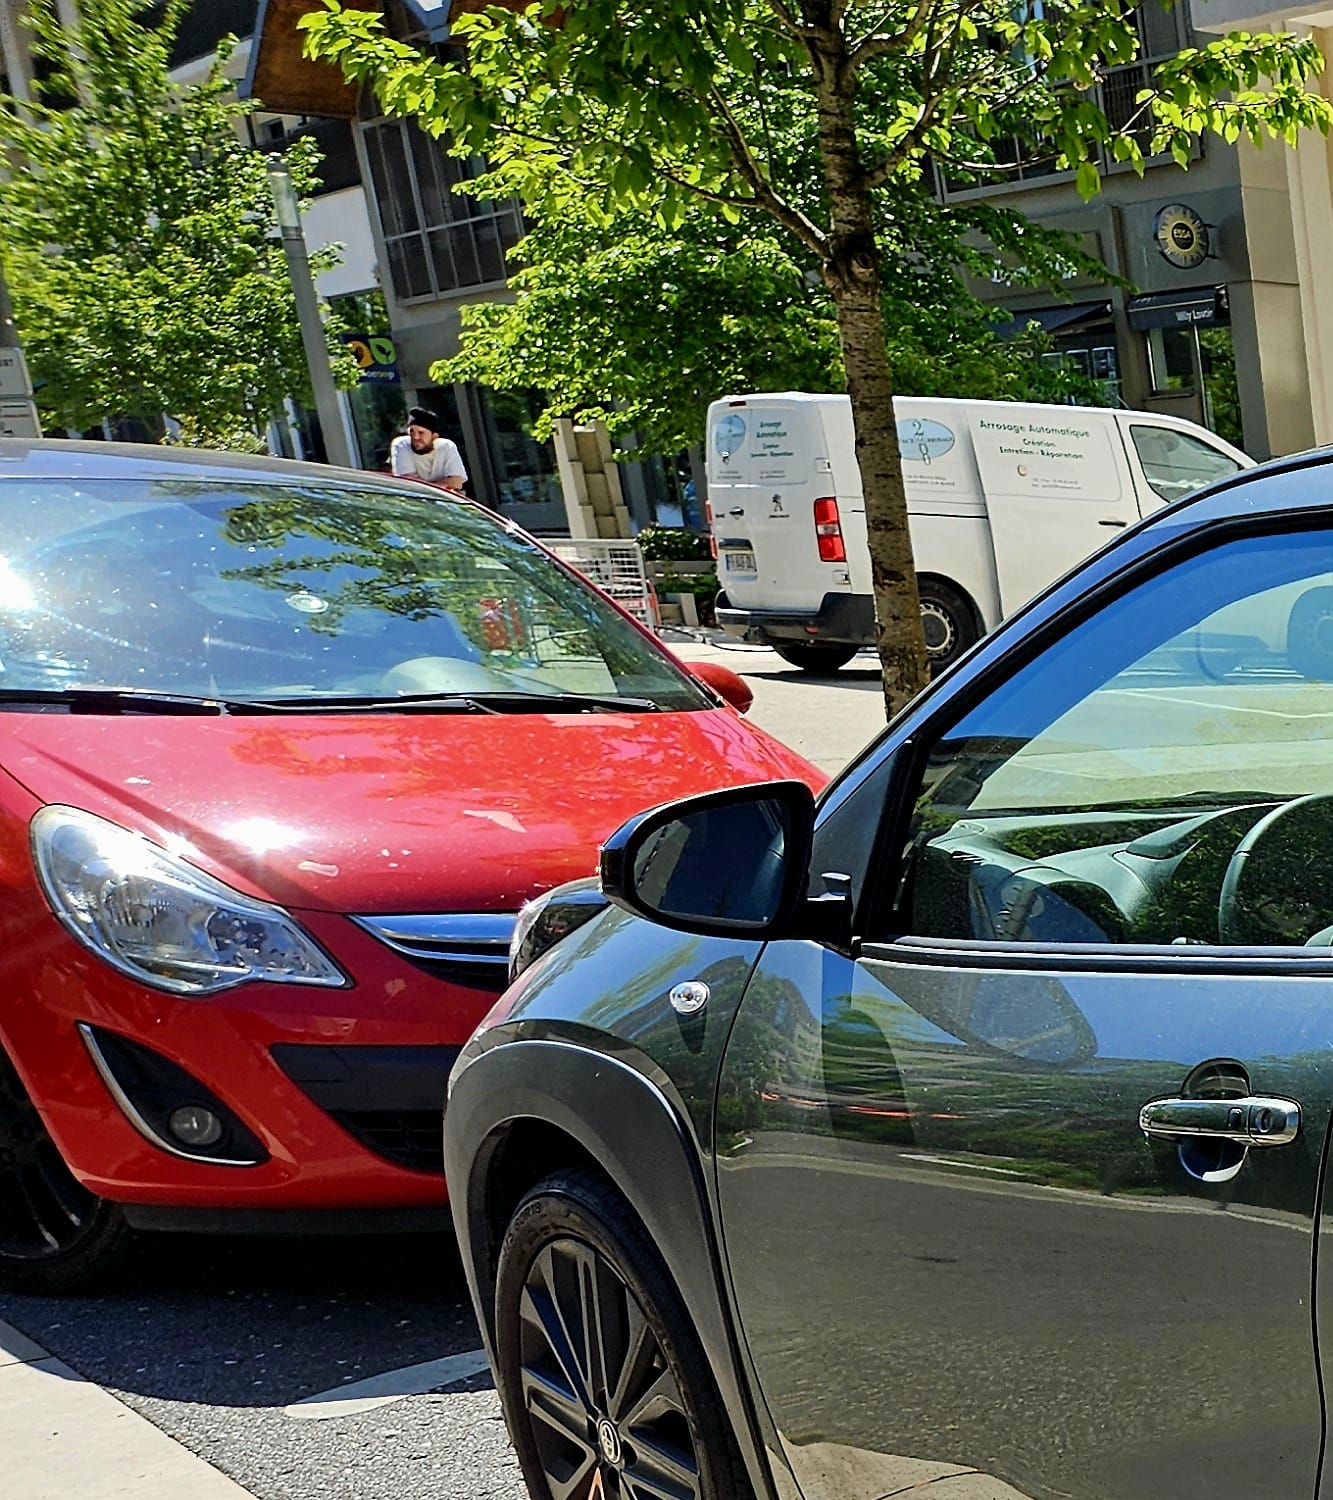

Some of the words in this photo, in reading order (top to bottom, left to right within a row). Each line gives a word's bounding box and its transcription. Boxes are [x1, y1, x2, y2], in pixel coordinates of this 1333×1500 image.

[980, 420, 1025, 434] Arrosage
[1029, 424, 1090, 439] Automatique
[1022, 438, 1056, 448] Création
[999, 446, 1035, 456] Entretien
[1040, 449, 1084, 459] Réparation
